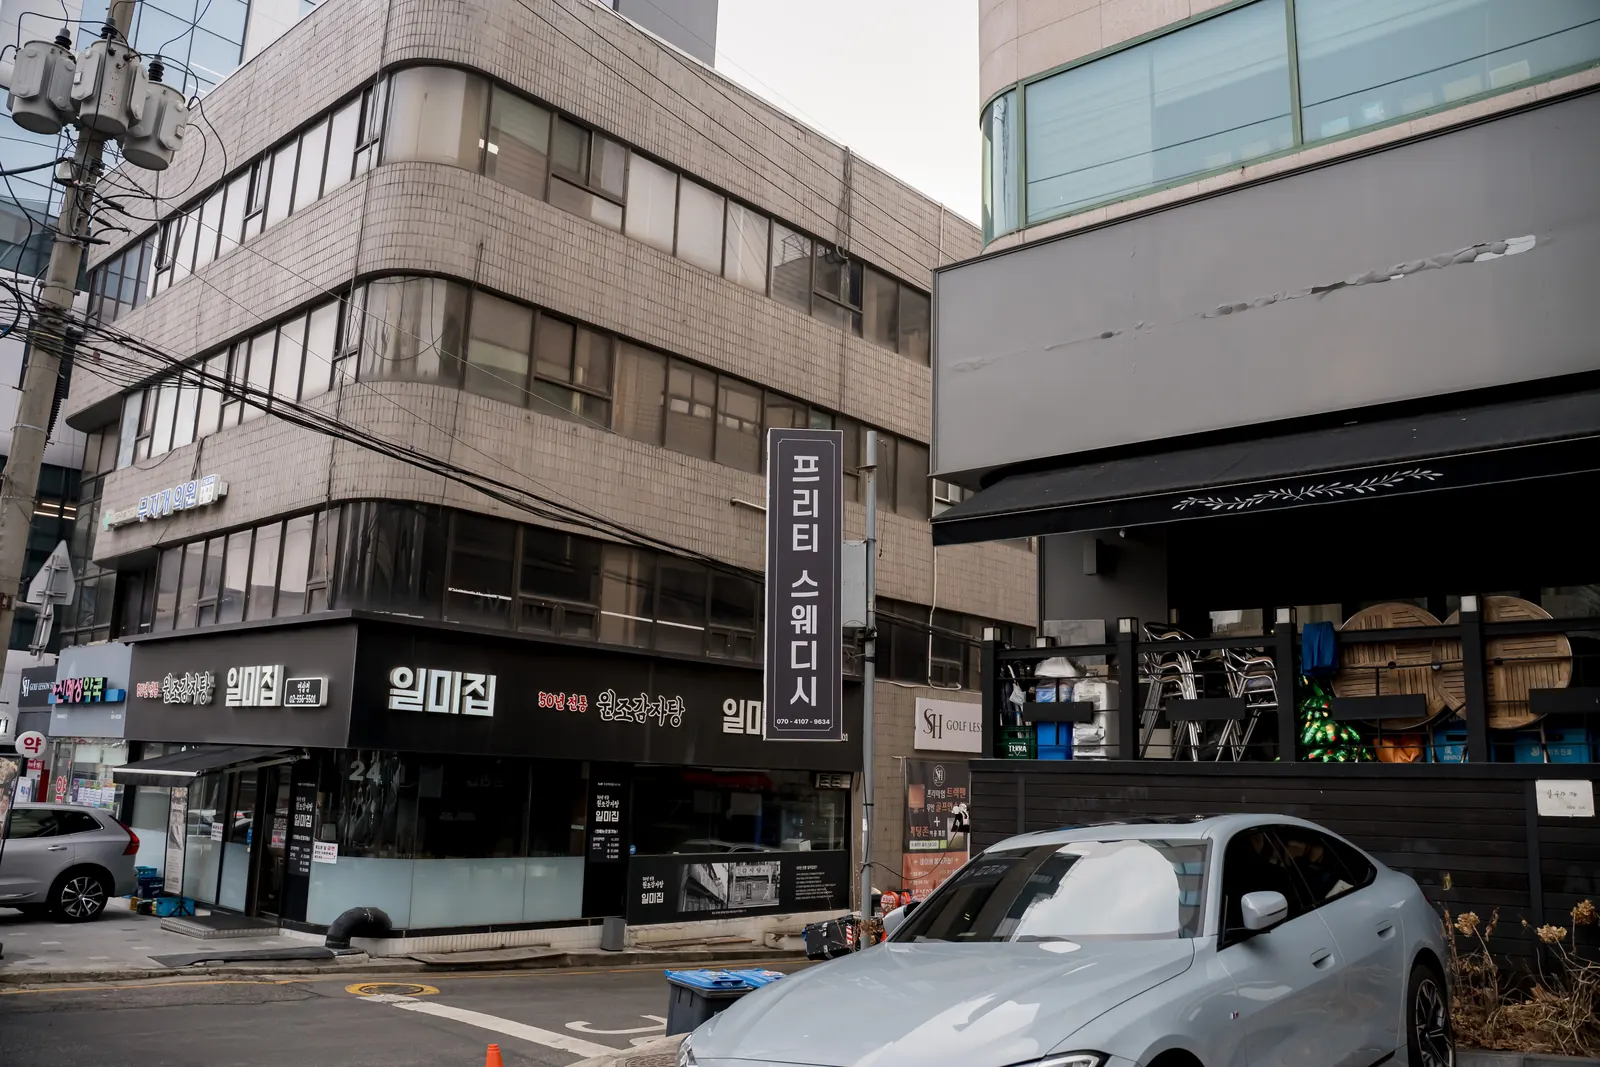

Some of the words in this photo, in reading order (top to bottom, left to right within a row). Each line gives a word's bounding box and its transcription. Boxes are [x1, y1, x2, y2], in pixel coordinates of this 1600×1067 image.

[138, 488, 171, 523] 무지개
[172, 480, 199, 510] 의원
[792, 455, 820, 553] 프리티
[790, 569, 819, 707] 스웨디시
[162, 671, 212, 705] 원조감자탕
[225, 665, 283, 707] 일미집
[388, 666, 497, 717] 일미집
[538, 691, 566, 711] 50년
[567, 693, 588, 713] 전통
[596, 688, 685, 727] 원조감자탕
[723, 698, 763, 735] 일미
[946, 719, 967, 731] GOLF
[24, 737, 42, 753] 약
[595, 810, 620, 822] 일미집
[641, 892, 664, 905] 일미집
